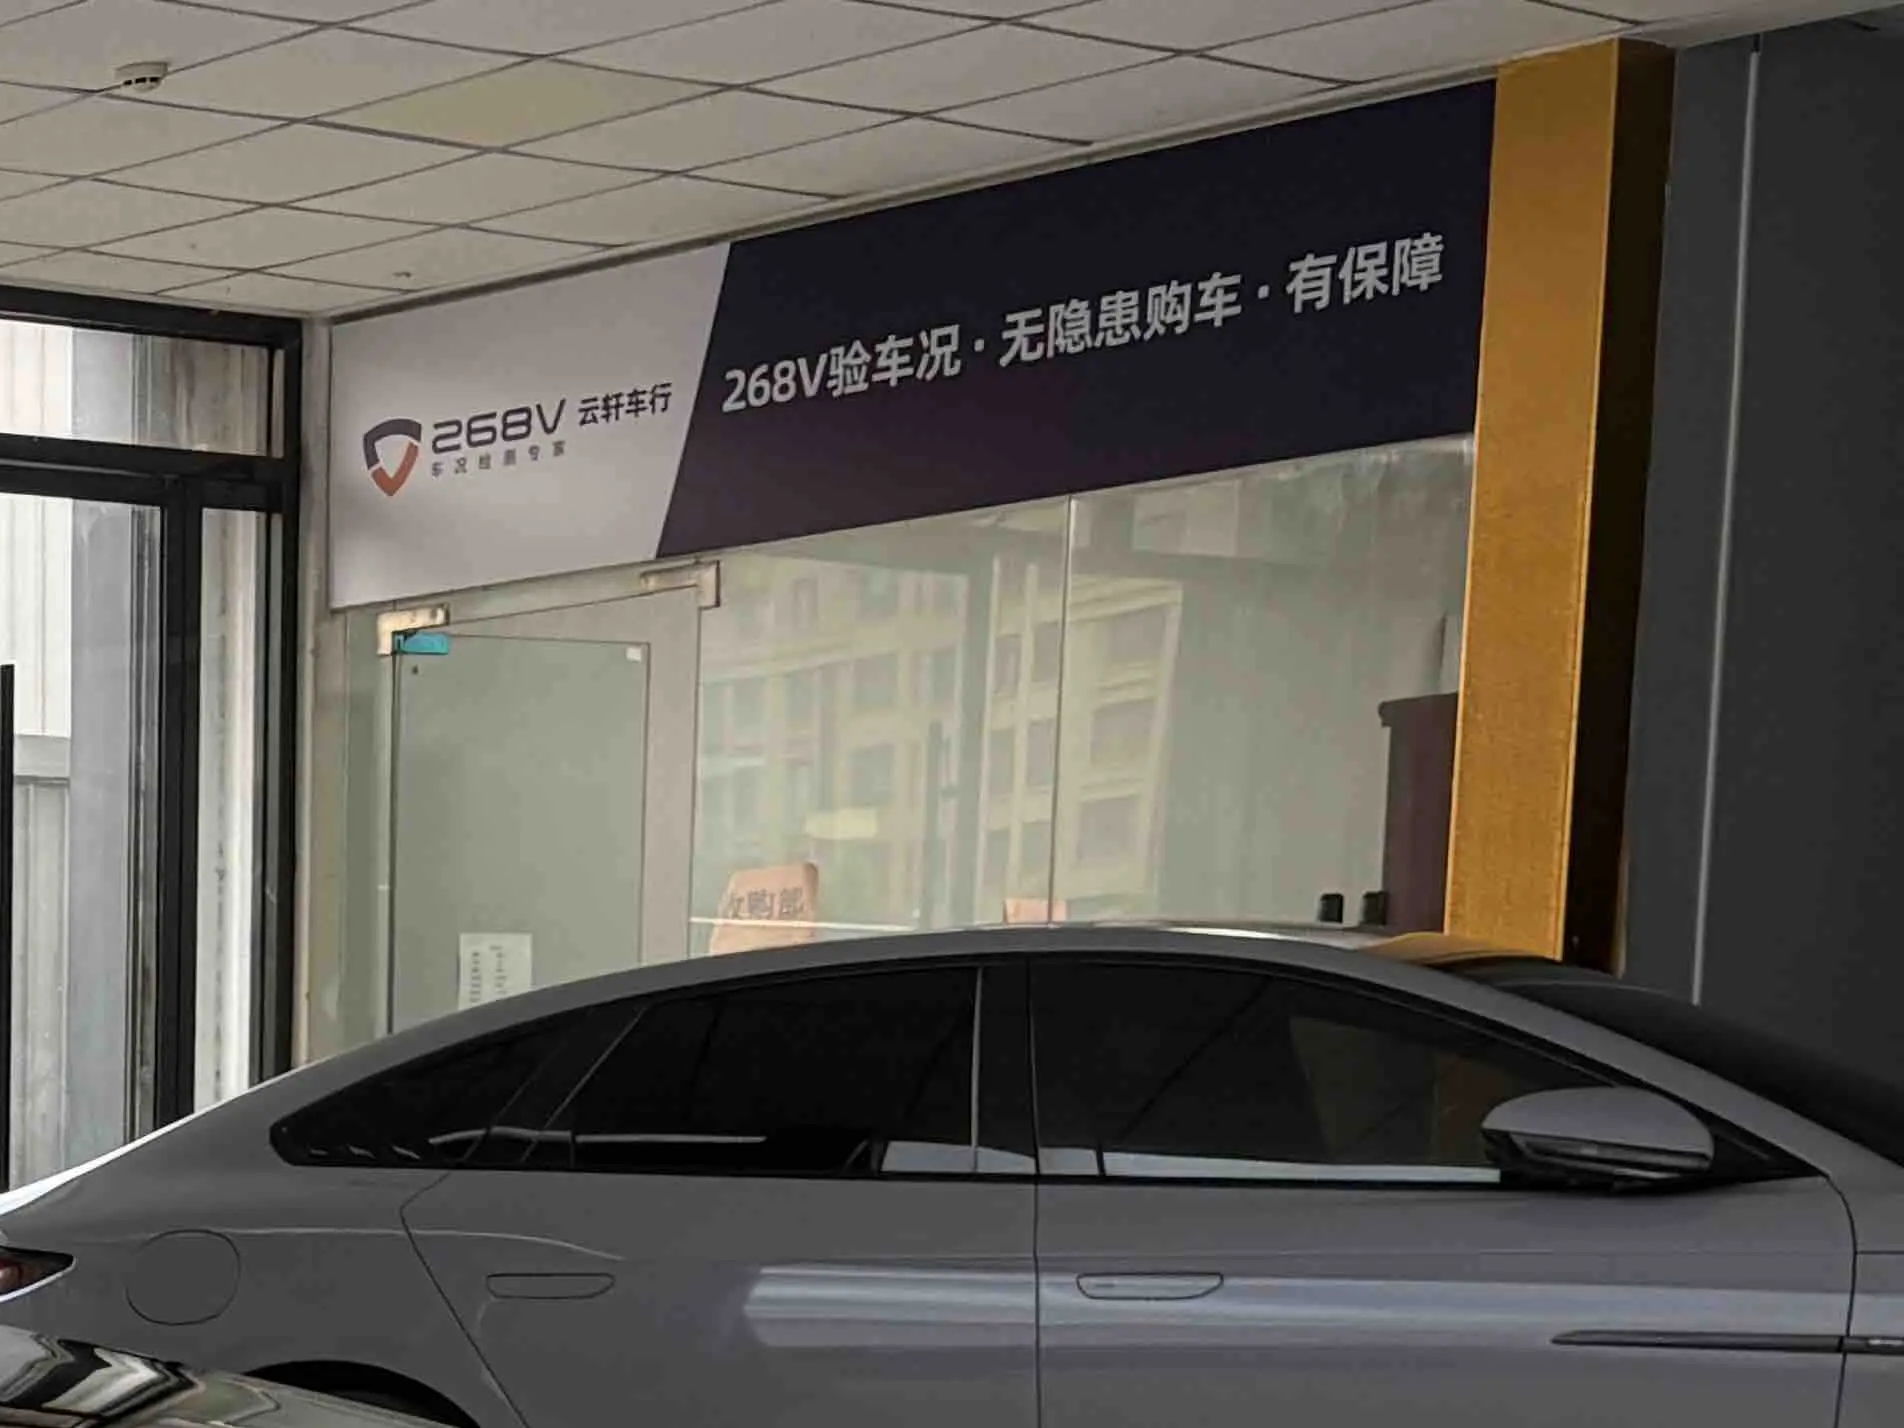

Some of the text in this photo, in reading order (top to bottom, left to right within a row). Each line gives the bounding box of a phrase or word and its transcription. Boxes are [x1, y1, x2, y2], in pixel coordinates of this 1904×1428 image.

[431, 382, 673, 454] 268V 云轩车行
